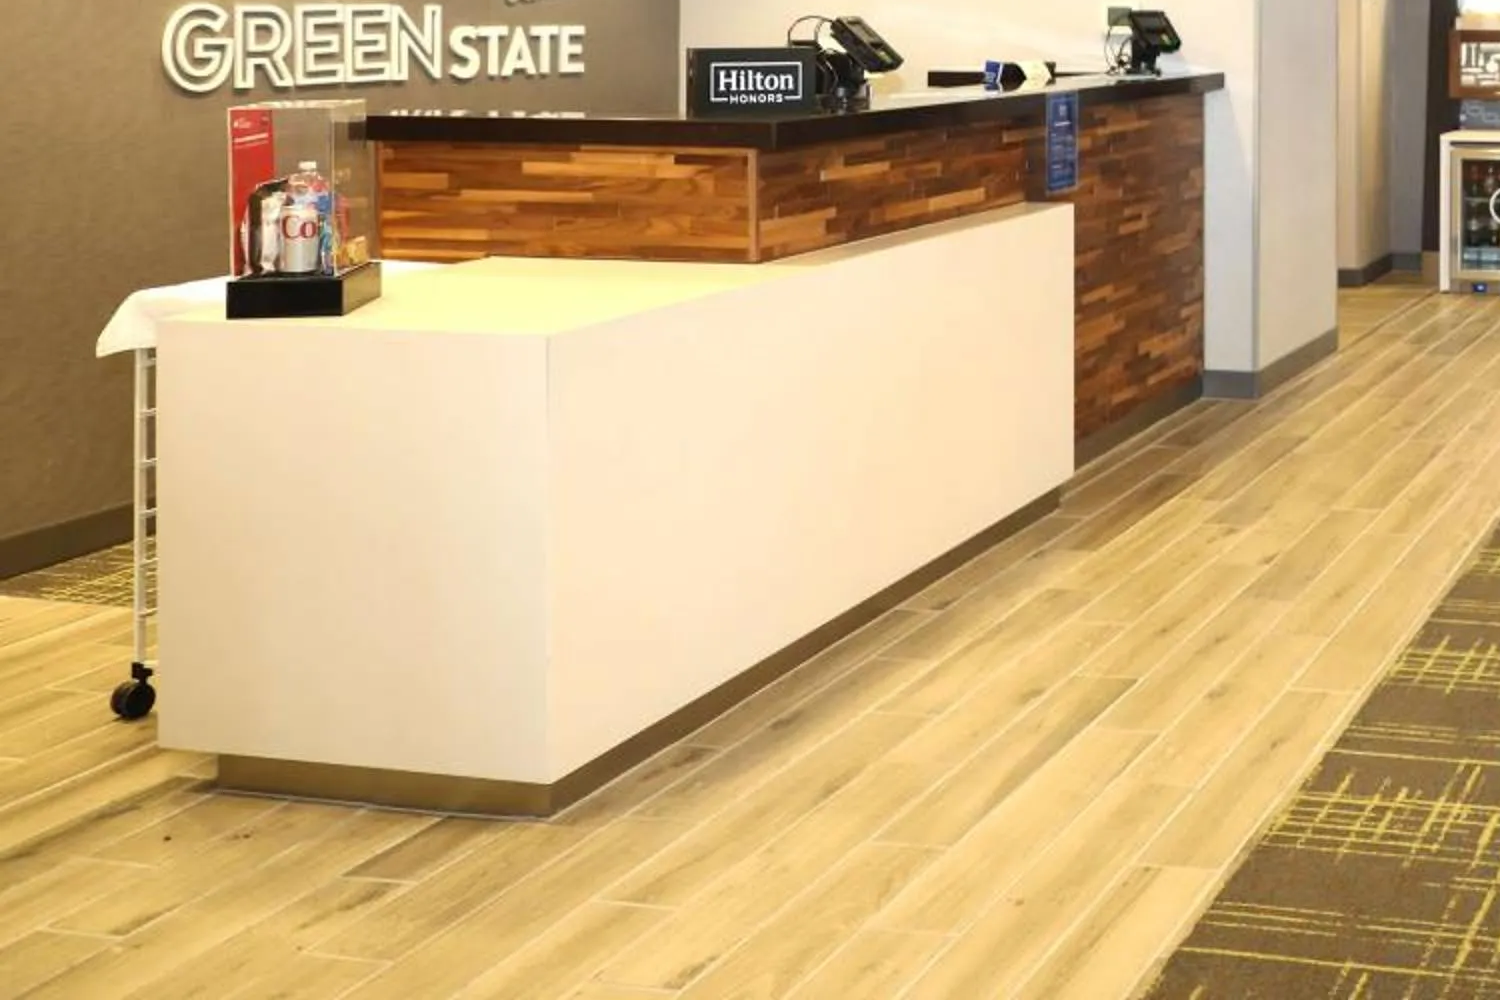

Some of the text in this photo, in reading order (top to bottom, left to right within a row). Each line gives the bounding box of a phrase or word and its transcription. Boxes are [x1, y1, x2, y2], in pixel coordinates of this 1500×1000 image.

[161, 1, 587, 93] GREEN STATE
[718, 69, 795, 92] Hilton
[729, 93, 784, 104] HONORS
